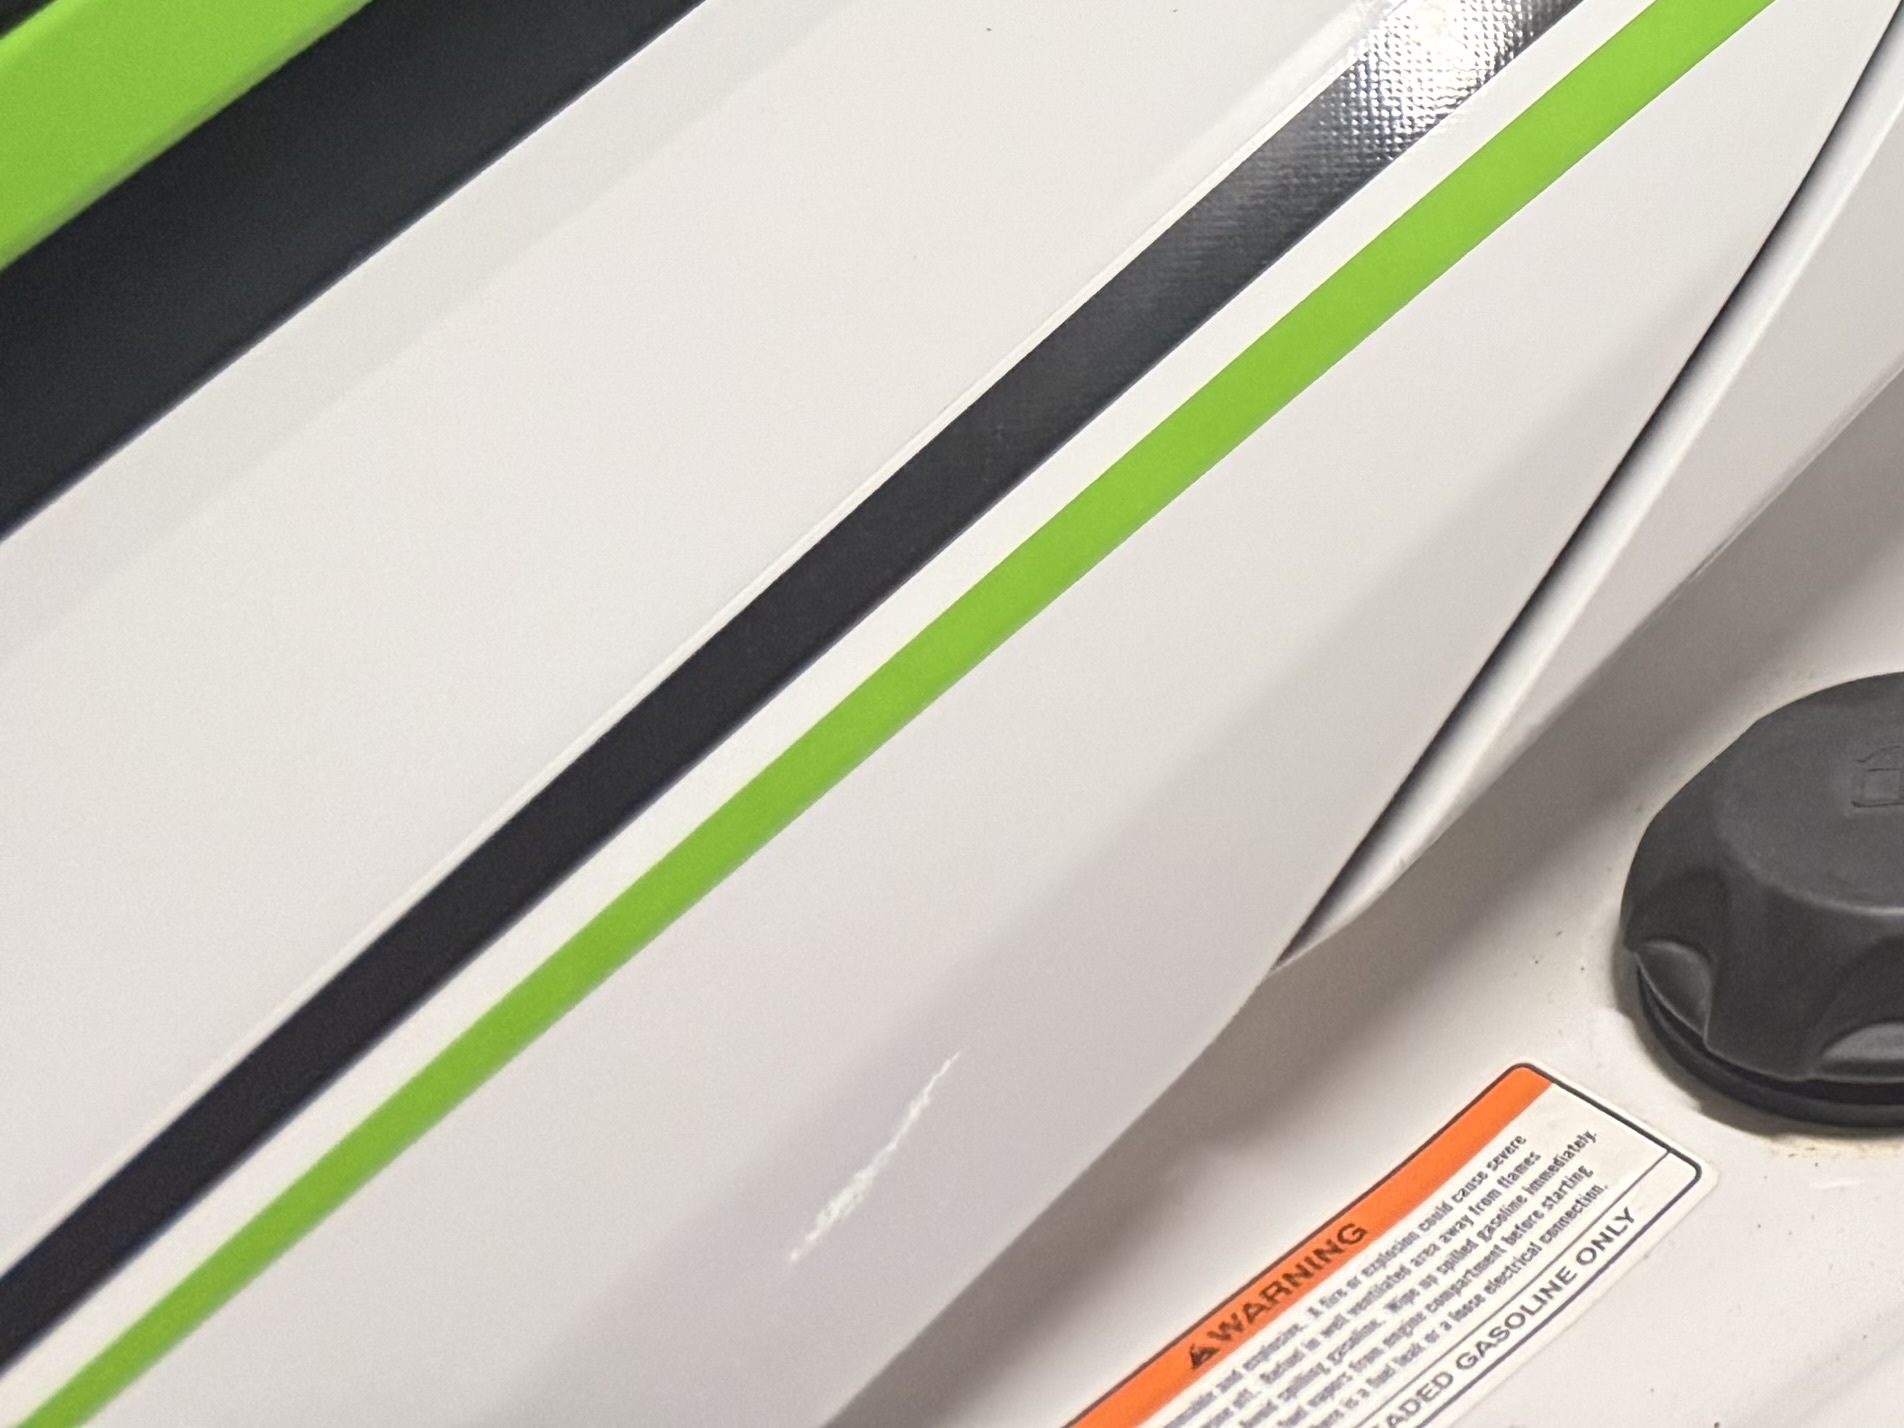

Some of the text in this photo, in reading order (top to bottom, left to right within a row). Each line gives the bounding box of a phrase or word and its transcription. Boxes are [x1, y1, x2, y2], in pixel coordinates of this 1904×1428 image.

[1417, 1200, 1454, 1232] could
[1450, 1170, 1489, 1203] cause
[1486, 1135, 1527, 1171] severe
[1438, 1214, 1474, 1244] away
[1467, 1188, 1502, 1216] from
[1496, 1151, 1541, 1189] flames
[1476, 1194, 1528, 1242] gasoline
[1522, 1131, 1596, 1195] immediately.
[1500, 1209, 1545, 1246] before
[1541, 1165, 1594, 1210] starting
[1207, 1223, 1367, 1341] WARNING
[1455, 1266, 1577, 1370] GASOLINE
[1575, 1207, 1634, 1266] ONLY
[1483, 1241, 1542, 1295] electrical
[1539, 1184, 1607, 1244] connection.
